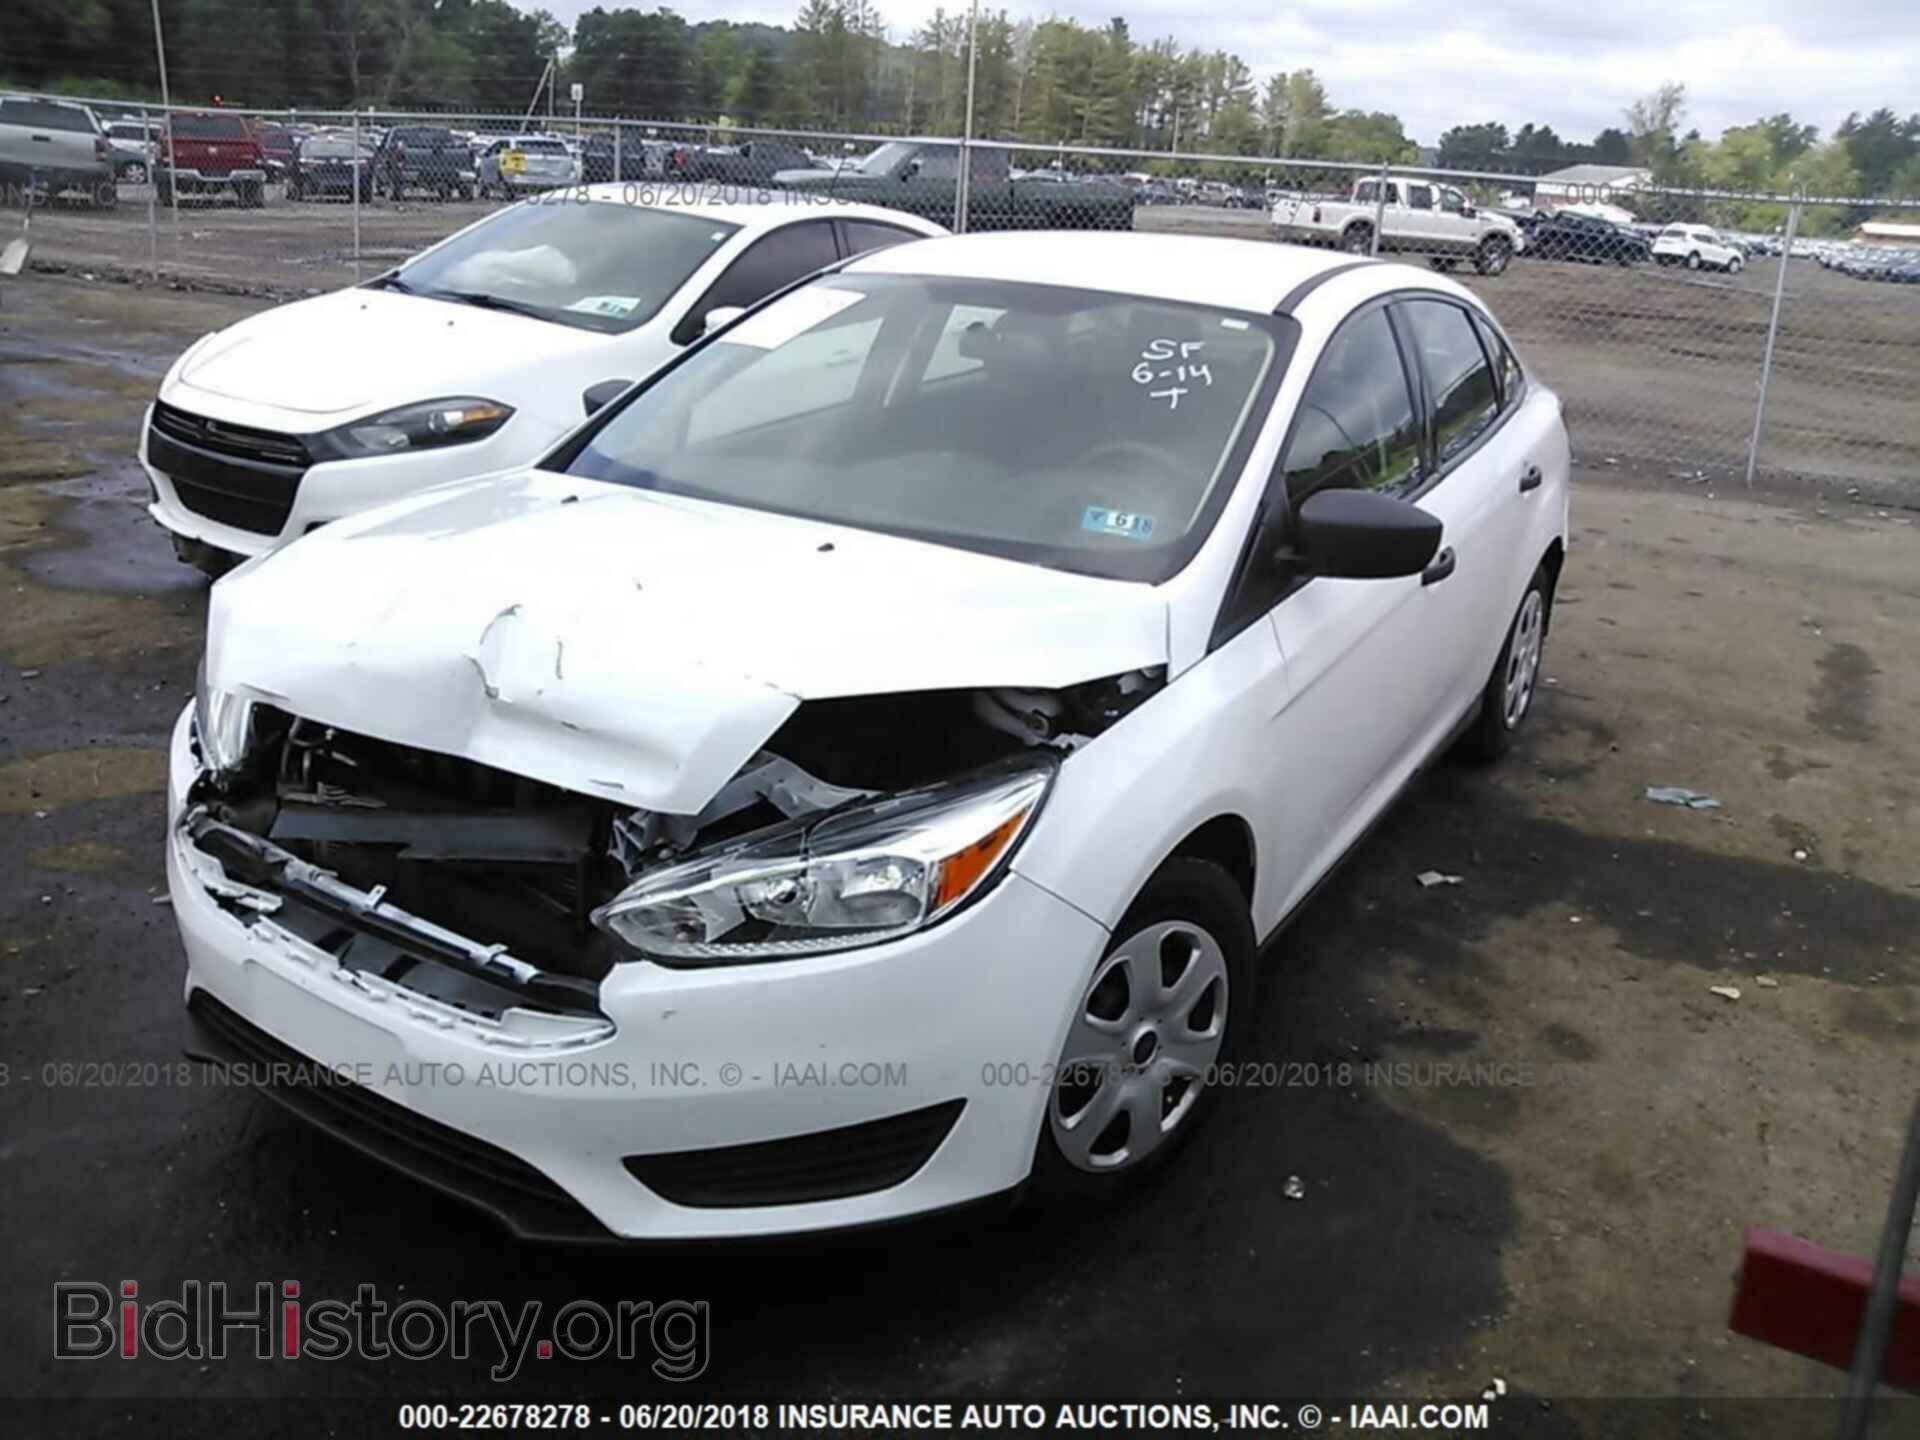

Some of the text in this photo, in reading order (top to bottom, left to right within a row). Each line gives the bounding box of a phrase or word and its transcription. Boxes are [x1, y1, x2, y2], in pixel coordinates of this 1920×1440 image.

[1142, 339, 1206, 359] SF
[1131, 361, 1212, 386] 6-14
[1115, 512, 1127, 527] 6
